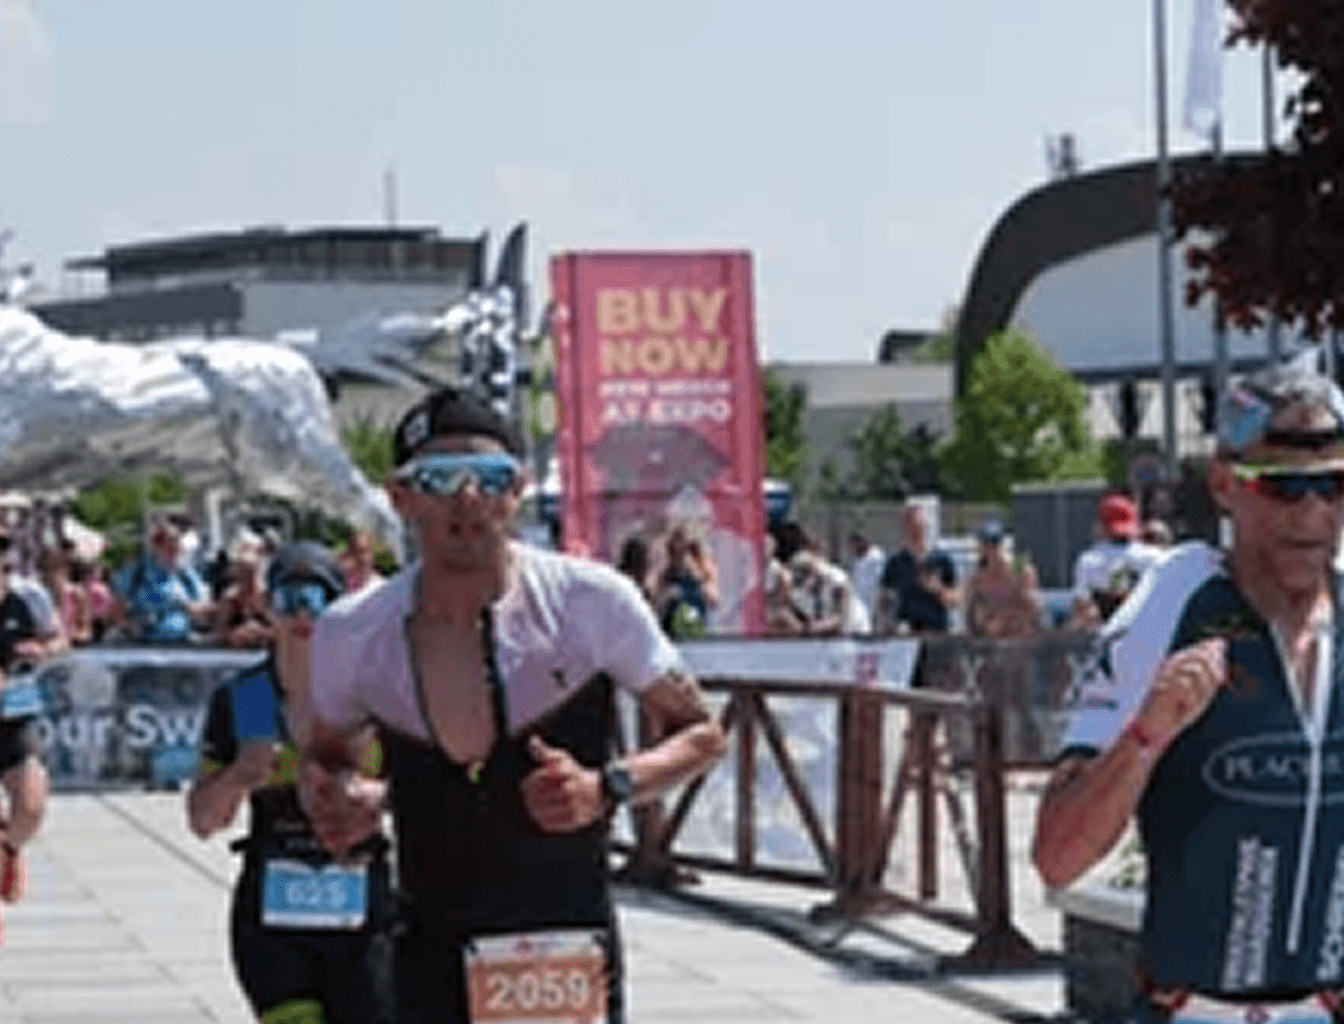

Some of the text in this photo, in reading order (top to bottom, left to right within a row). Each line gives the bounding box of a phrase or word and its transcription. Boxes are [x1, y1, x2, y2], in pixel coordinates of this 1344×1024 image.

[595, 287, 727, 333] BUY
[599, 338, 730, 374] NOW
[649, 399, 732, 423] EXPO
[484, 967, 591, 1011] 2059
